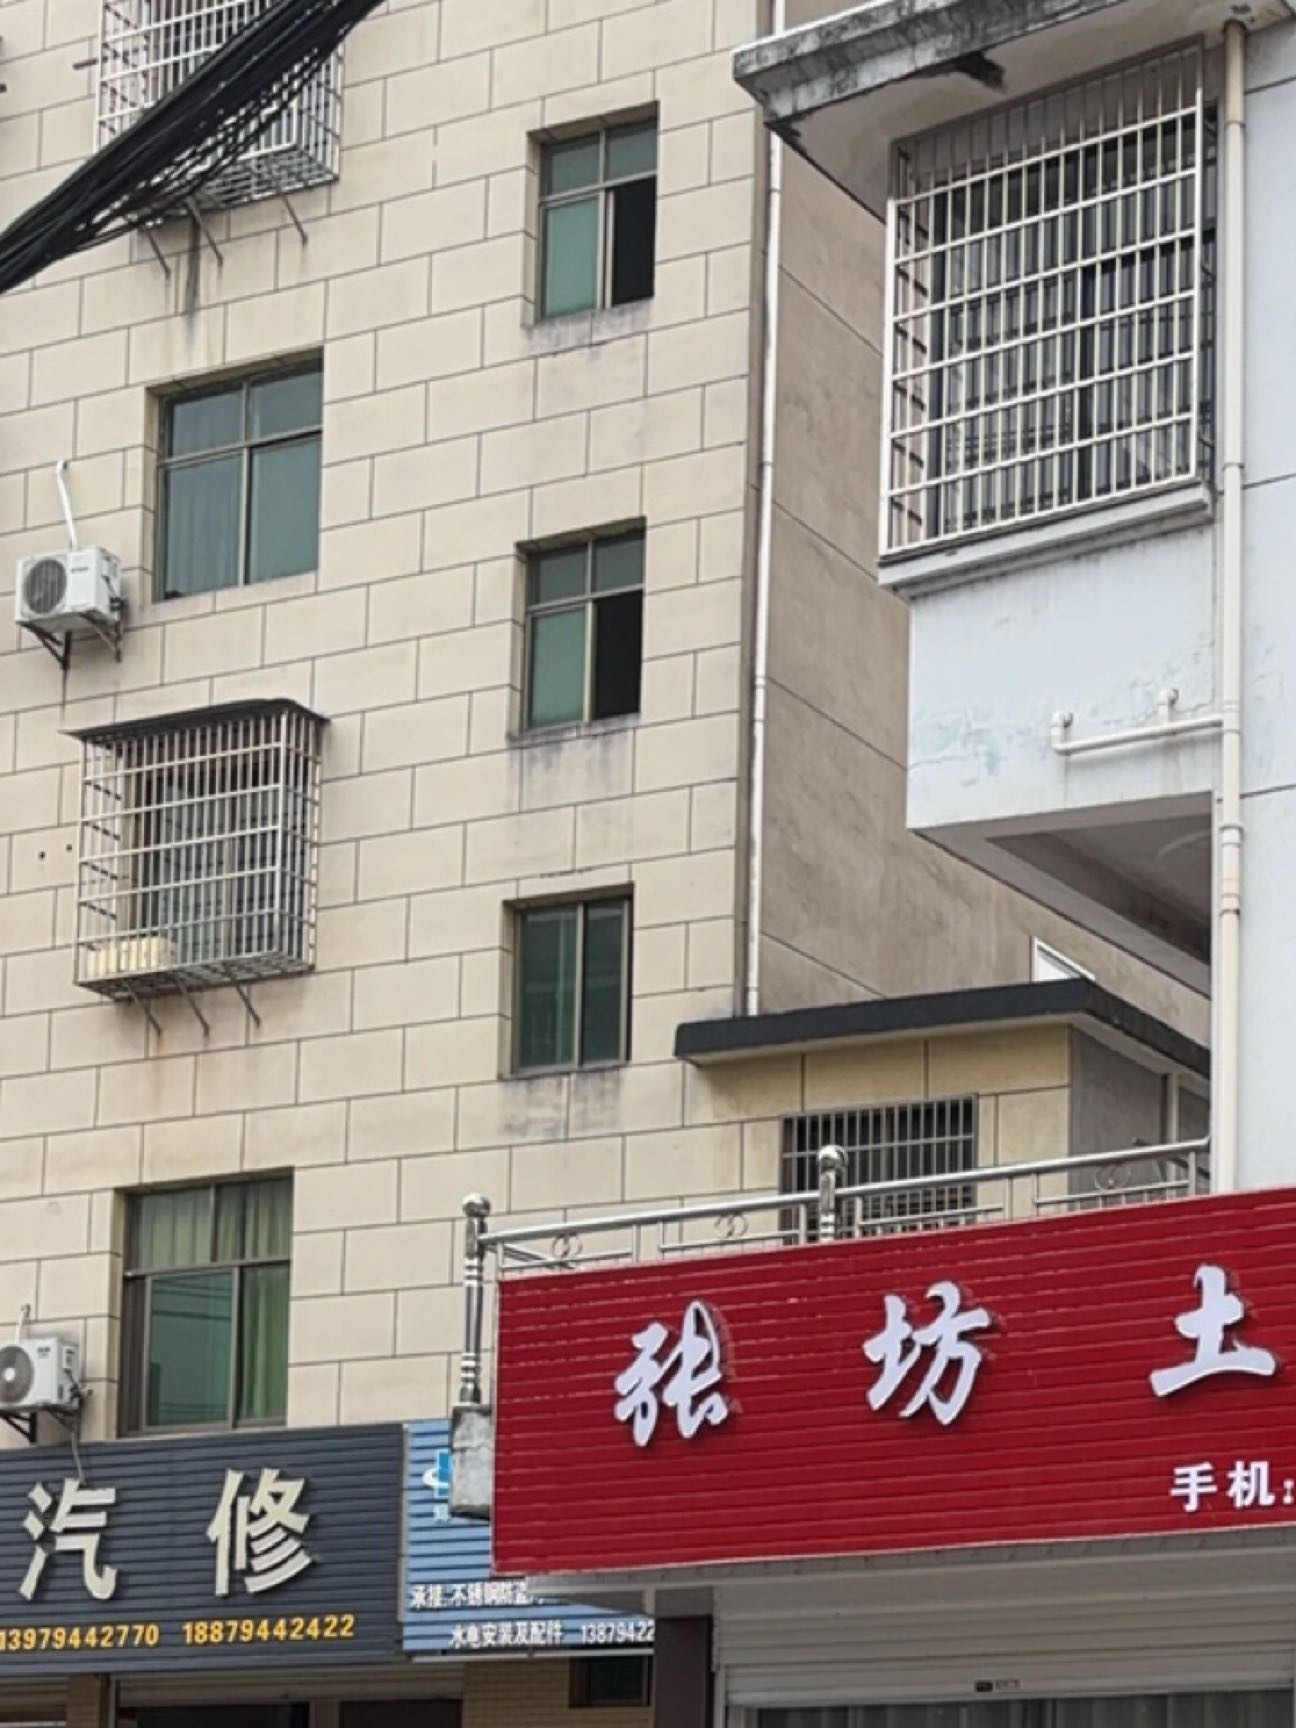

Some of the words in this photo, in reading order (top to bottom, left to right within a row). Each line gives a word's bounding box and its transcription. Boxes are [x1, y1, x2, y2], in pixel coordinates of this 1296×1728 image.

[1170, 1460, 1296, 1513] 手机:
[19, 1467, 318, 1600] 汽修
[0, 1624, 160, 1650] 13979442770
[182, 1614, 356, 1644] 18879442422
